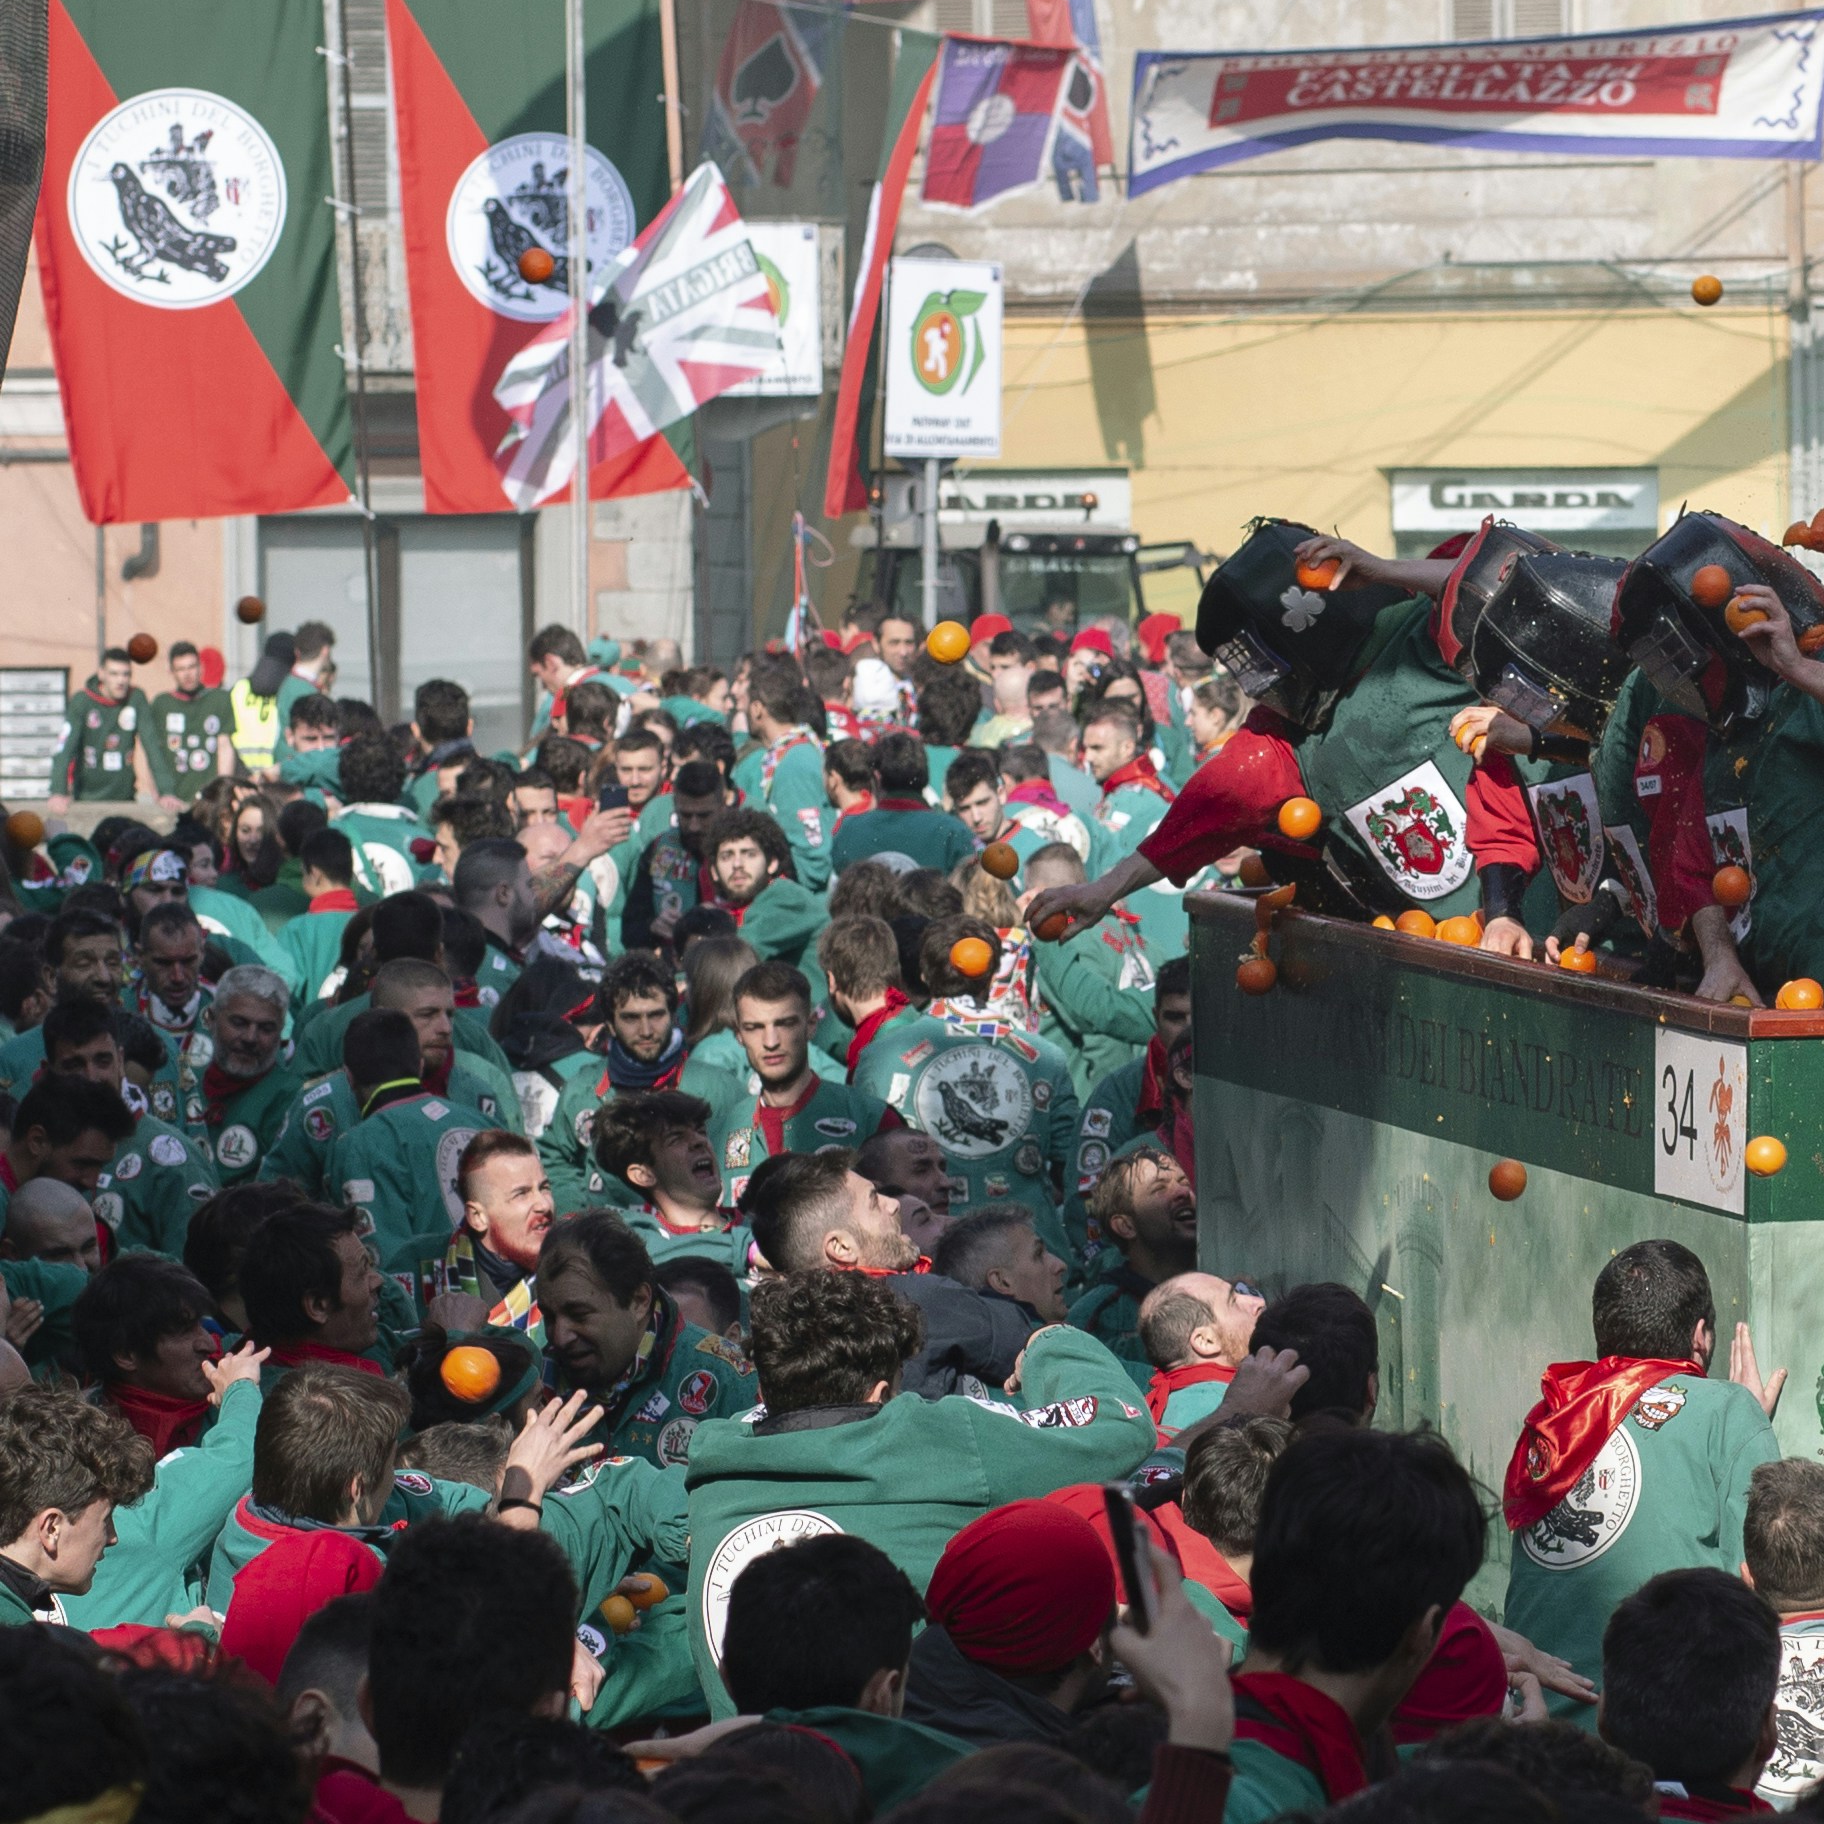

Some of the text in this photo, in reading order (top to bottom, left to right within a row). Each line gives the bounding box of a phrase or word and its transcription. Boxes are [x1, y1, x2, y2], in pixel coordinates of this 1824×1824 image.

[1286, 77, 1636, 107] CASTELLAZZO
[1396, 1013, 1450, 1090] DEI
[1458, 1028, 1643, 1139] BIANDRATE
[1661, 1064, 1698, 1162] 34
[1605, 1435, 1632, 1531] BORGHETTO
[716, 1518, 784, 1573] TUCHINI
[712, 1581, 723, 1589] I
